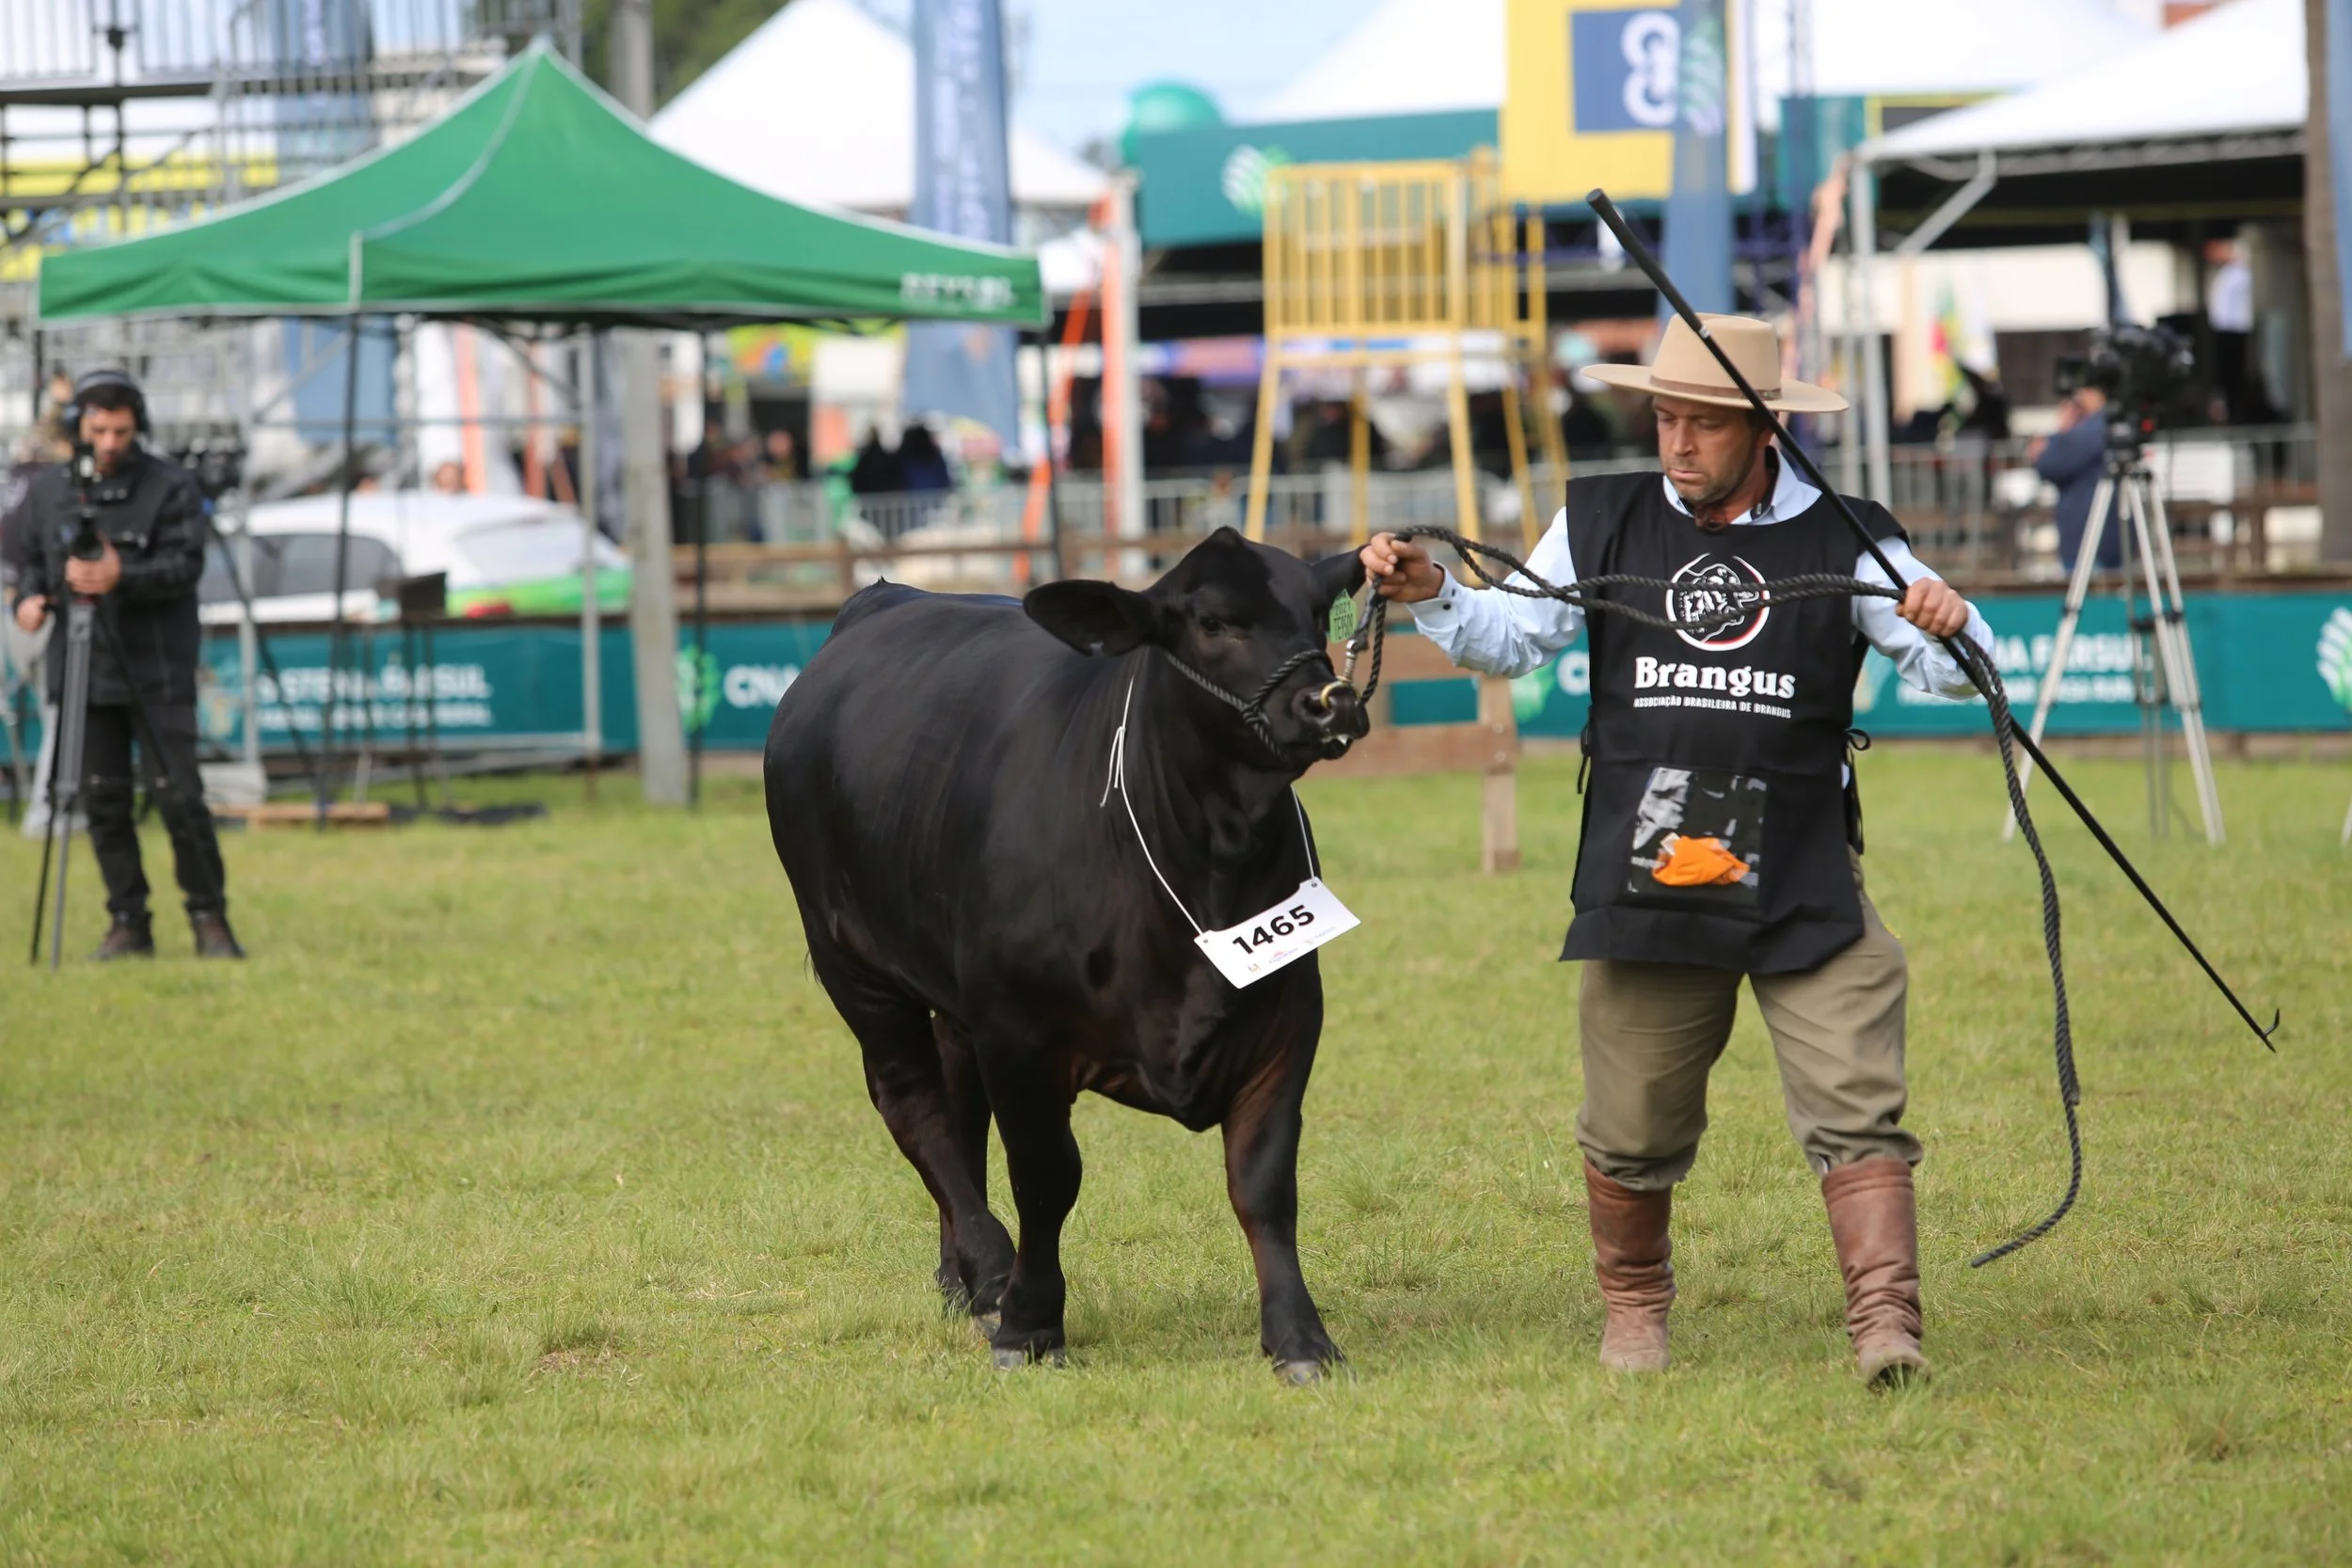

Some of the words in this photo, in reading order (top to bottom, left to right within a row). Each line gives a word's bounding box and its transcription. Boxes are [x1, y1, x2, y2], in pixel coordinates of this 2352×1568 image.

[1334, 600, 1351, 616] 2021
[1634, 656, 1797, 699] Brangus
[1633, 694, 1682, 708] ASSOCIAÇÃO
[1683, 696, 1738, 711] BRASILEIRA
[1739, 701, 1752, 713] DE
[1754, 703, 1791, 719] BRANGUS
[1232, 904, 1315, 955] 1465
